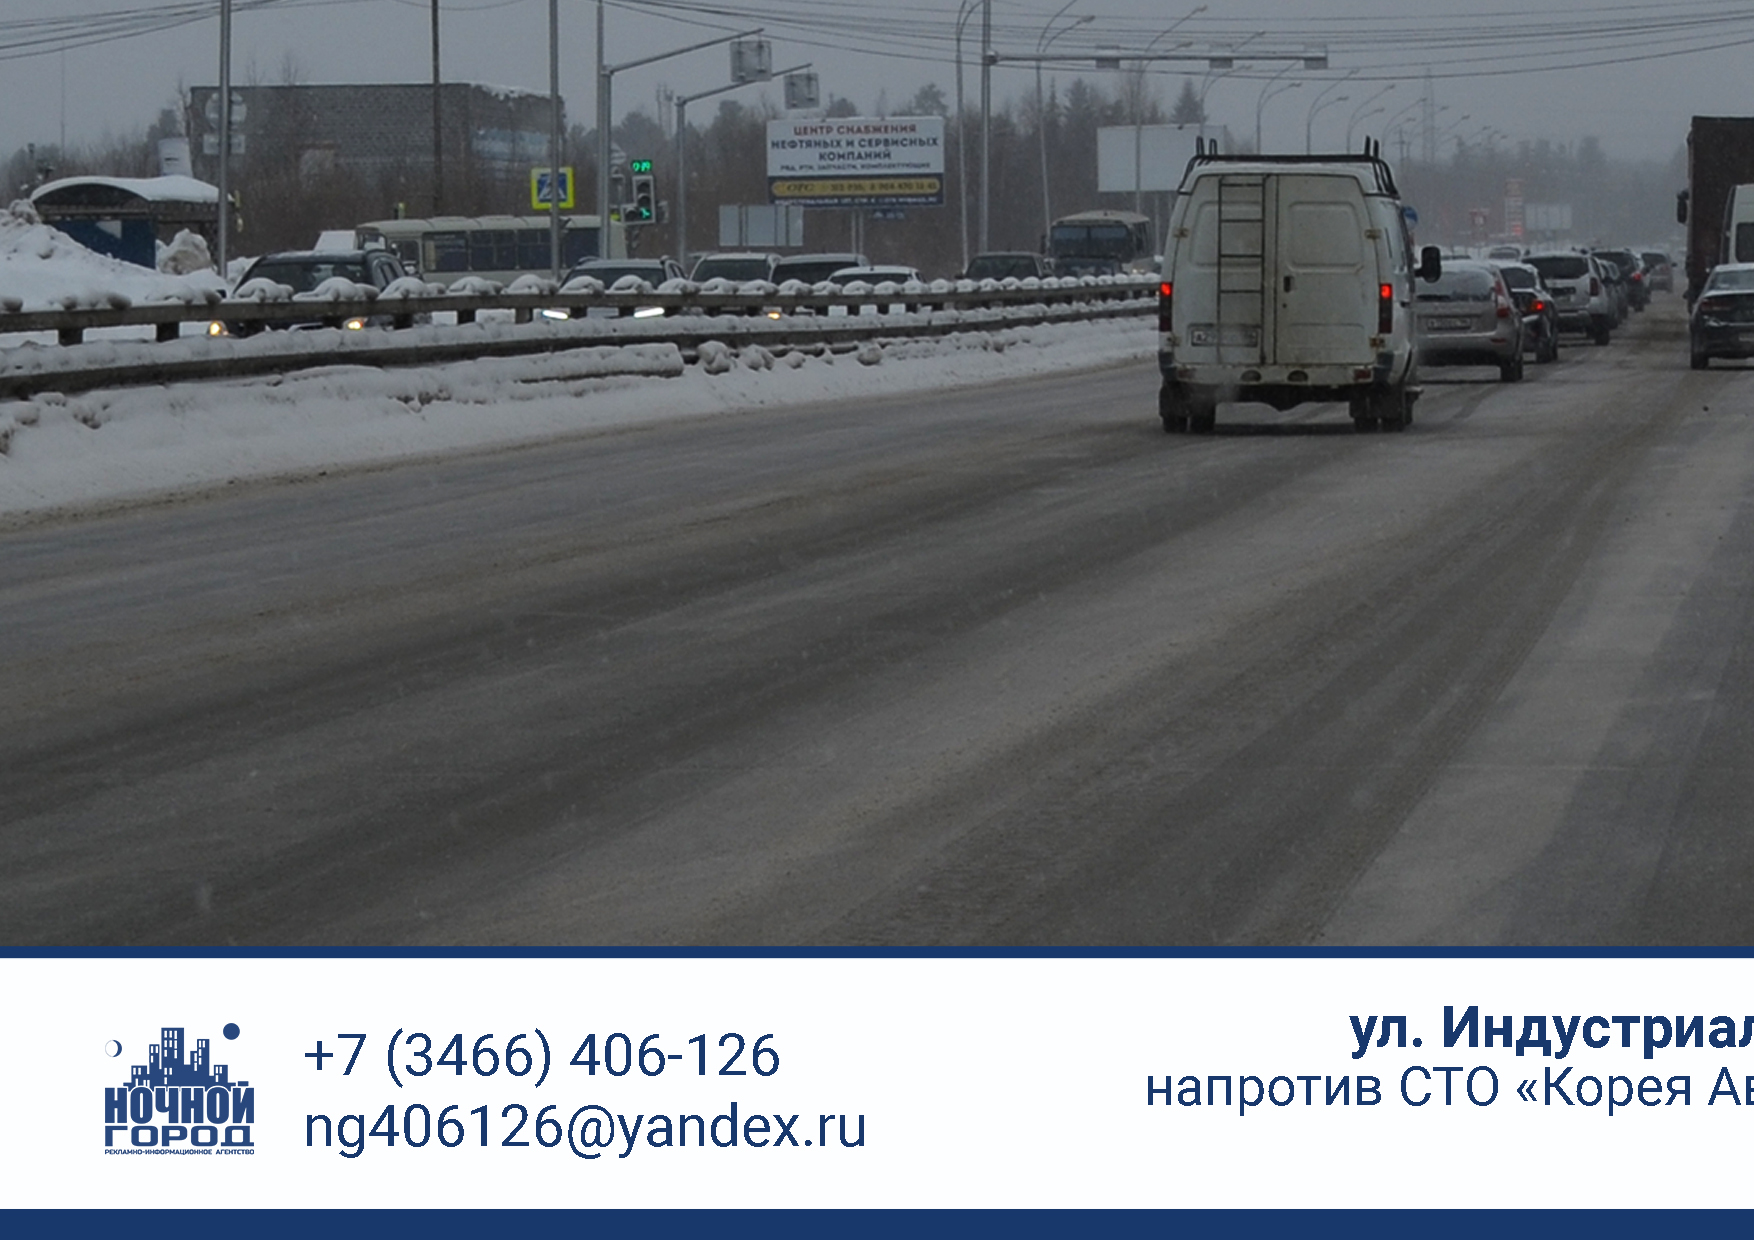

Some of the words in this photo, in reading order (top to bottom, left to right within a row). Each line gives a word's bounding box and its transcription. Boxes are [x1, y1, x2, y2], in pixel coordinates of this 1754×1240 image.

[794, 125, 834, 136] ЦЕНТР
[836, 124, 917, 135] СНАБЖЕНИЯ
[771, 138, 843, 150] НЕФТЯНЫХ
[845, 139, 854, 149] И
[858, 137, 939, 149] СЕРВИСНЫХ
[819, 148, 892, 161] КОМПАНИЙ
